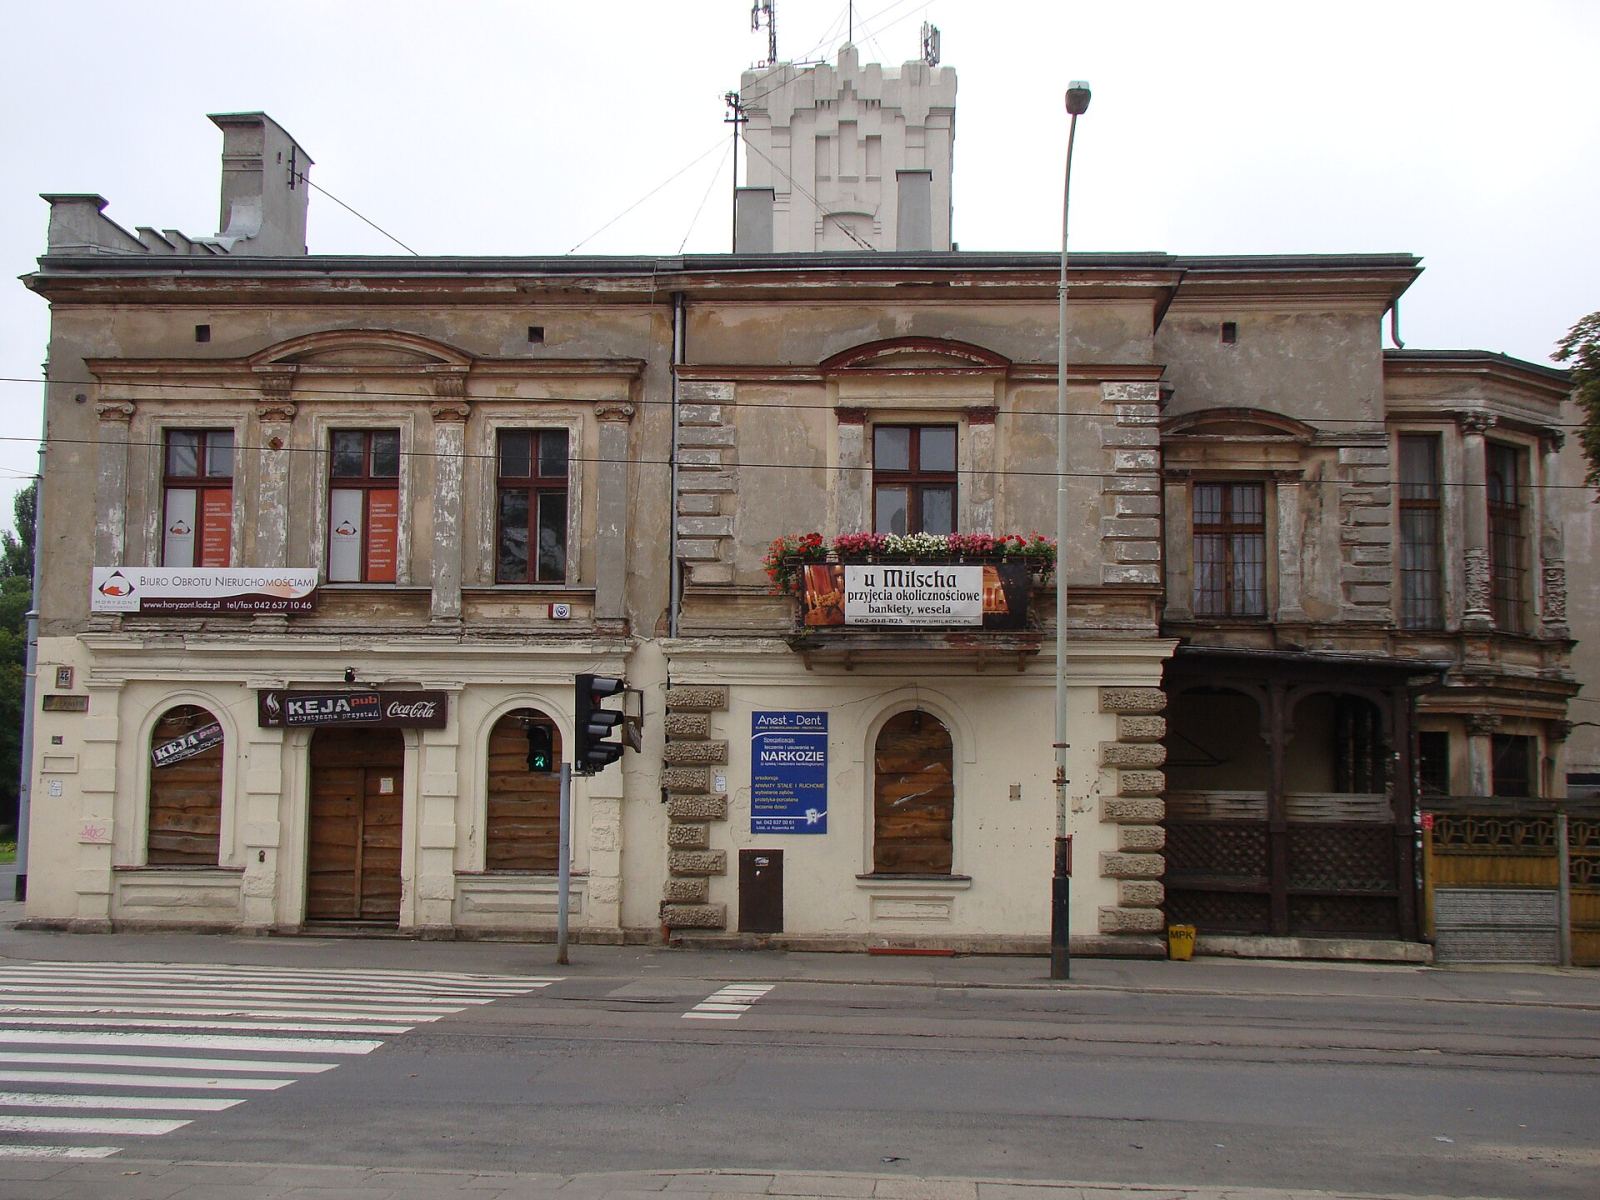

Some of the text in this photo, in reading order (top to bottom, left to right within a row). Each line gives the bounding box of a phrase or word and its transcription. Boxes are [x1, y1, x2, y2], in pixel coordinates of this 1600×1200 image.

[140, 576, 315, 588] BIURO OBROTU NIERUCHOMOŚCIAMI
[864, 569, 957, 588] u Milscha
[847, 588, 980, 604] przyjęcia okolicznościowe
[143, 600, 221, 611] www.horyzont.lodz.pl
[227, 600, 253, 610] tel/fax
[254, 601, 271, 610] 042
[272, 601, 288, 610] 637
[289, 601, 300, 610] 10
[301, 601, 313, 610] 46
[868, 604, 952, 616] bankiety, wesela
[60, 673, 70, 681] 46
[288, 695, 378, 715] KEJA pub
[386, 701, 437, 719] Coca-Cola
[289, 710, 379, 723] artystyczna przystań
[757, 715, 788, 726] Anest
[796, 715, 822, 726] Dent
[155, 726, 220, 761] KEJA pub
[760, 751, 825, 762] NARKOZIE
[1170, 930, 1193, 940] MPK
